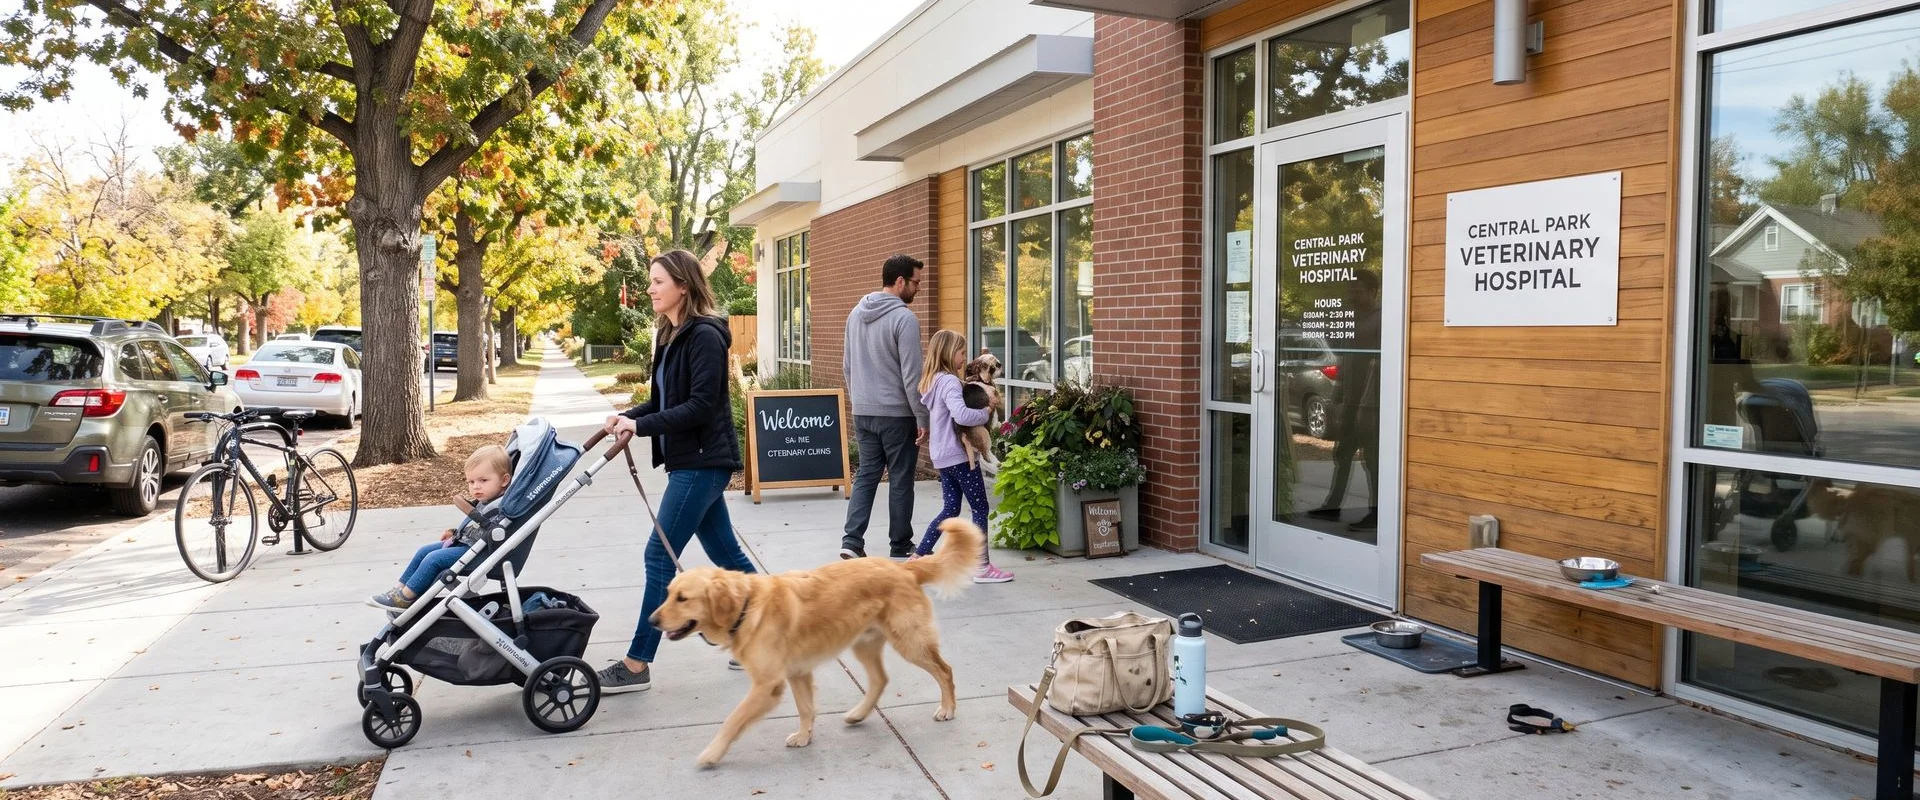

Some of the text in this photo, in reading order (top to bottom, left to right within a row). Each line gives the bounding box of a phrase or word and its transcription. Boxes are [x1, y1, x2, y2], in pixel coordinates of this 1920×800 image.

[1468, 213, 1591, 239] CENTRAL PARK
[1294, 232, 1365, 250] CENTRAL PARK
[1292, 248, 1367, 268] VETERINARY
[1460, 236, 1601, 266] VETERINARY
[1300, 267, 1358, 284] HOSPITAL
[1475, 267, 1582, 292] HOSPITAL
[1314, 298, 1342, 308] HOURS
[1344, 310, 1355, 318] PM
[1329, 321, 1344, 329] 2:30
[1345, 321, 1355, 329] PM
[1329, 331, 1344, 339] 2:30
[1345, 331, 1355, 339] PM
[759, 407, 834, 431] Welcome
